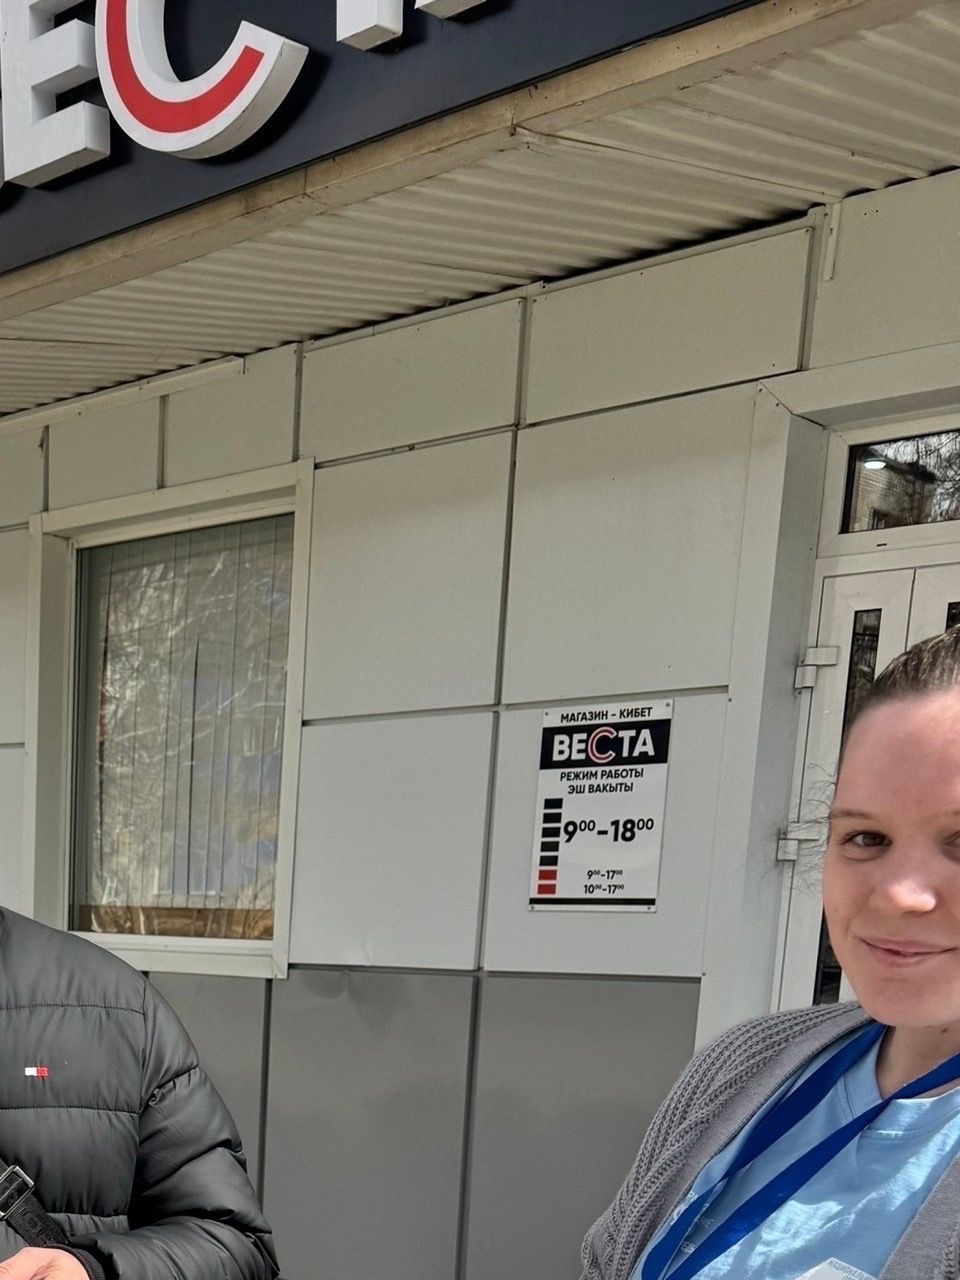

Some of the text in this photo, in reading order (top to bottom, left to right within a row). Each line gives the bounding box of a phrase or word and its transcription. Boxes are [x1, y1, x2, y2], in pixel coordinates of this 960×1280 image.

[560, 710, 608, 723] МАГАЗИН
[619, 707, 653, 719] КИБЕТ
[552, 726, 655, 764] ВЕСТА
[560, 768, 644, 782] РЕЖИМ РАБОТЫ
[567, 782, 634, 795] ЭШ ВАКЫТЫ
